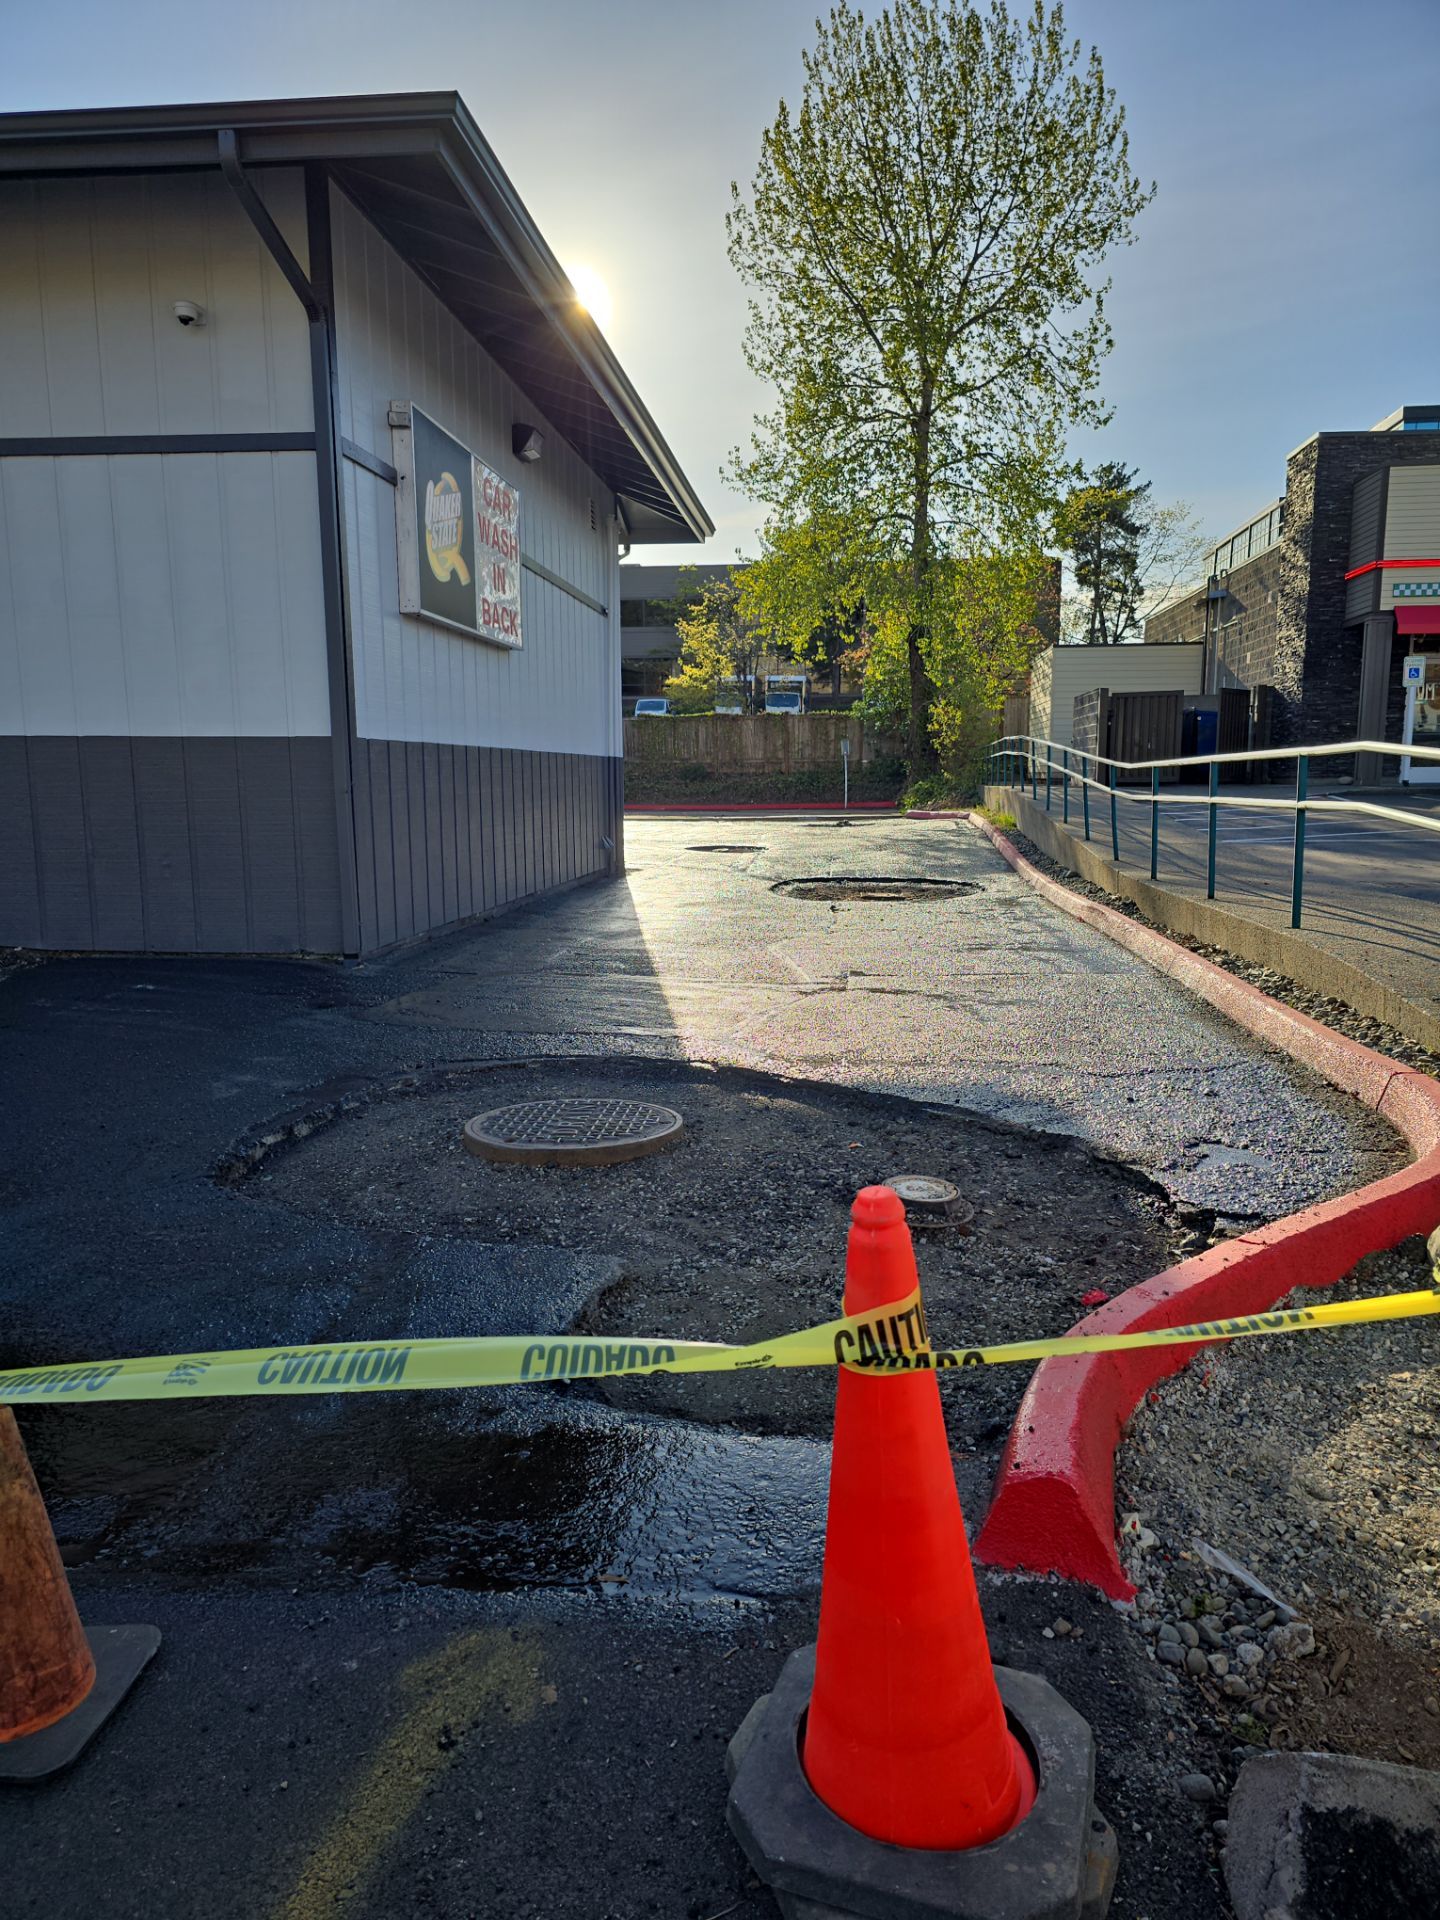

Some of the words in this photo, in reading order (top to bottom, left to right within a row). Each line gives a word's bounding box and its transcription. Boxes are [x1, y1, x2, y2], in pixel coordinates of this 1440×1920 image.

[425, 480, 461, 530] QUAKER
[483, 477, 511, 522] CAR
[431, 518, 458, 550] STATE
[478, 512, 518, 563] WASH
[493, 563, 506, 595] IN
[482, 597, 518, 637] BACK
[834, 1303, 927, 1366] CAUTI
